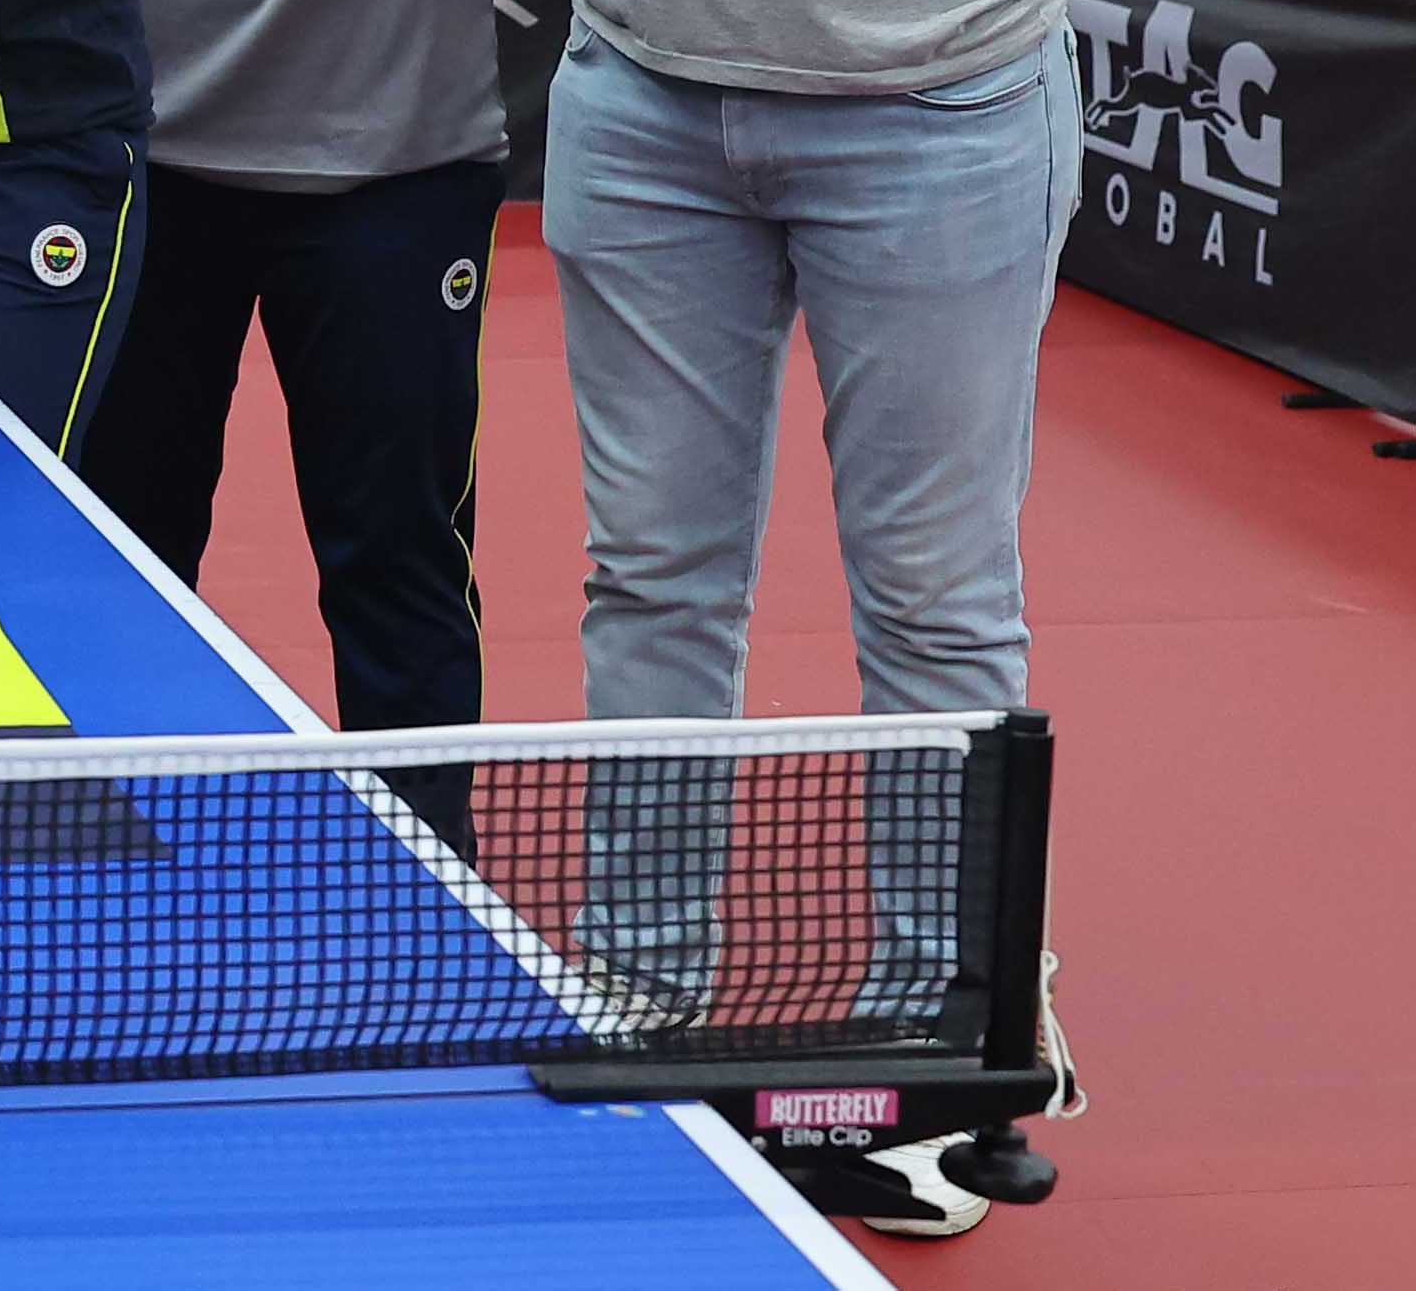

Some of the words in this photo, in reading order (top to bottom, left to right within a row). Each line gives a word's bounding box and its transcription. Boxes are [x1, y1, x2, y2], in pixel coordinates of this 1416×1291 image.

[771, 1092, 888, 1125] BUTTERFLY
[781, 1126, 825, 1148] Elite
[829, 1126, 873, 1148] Clip
